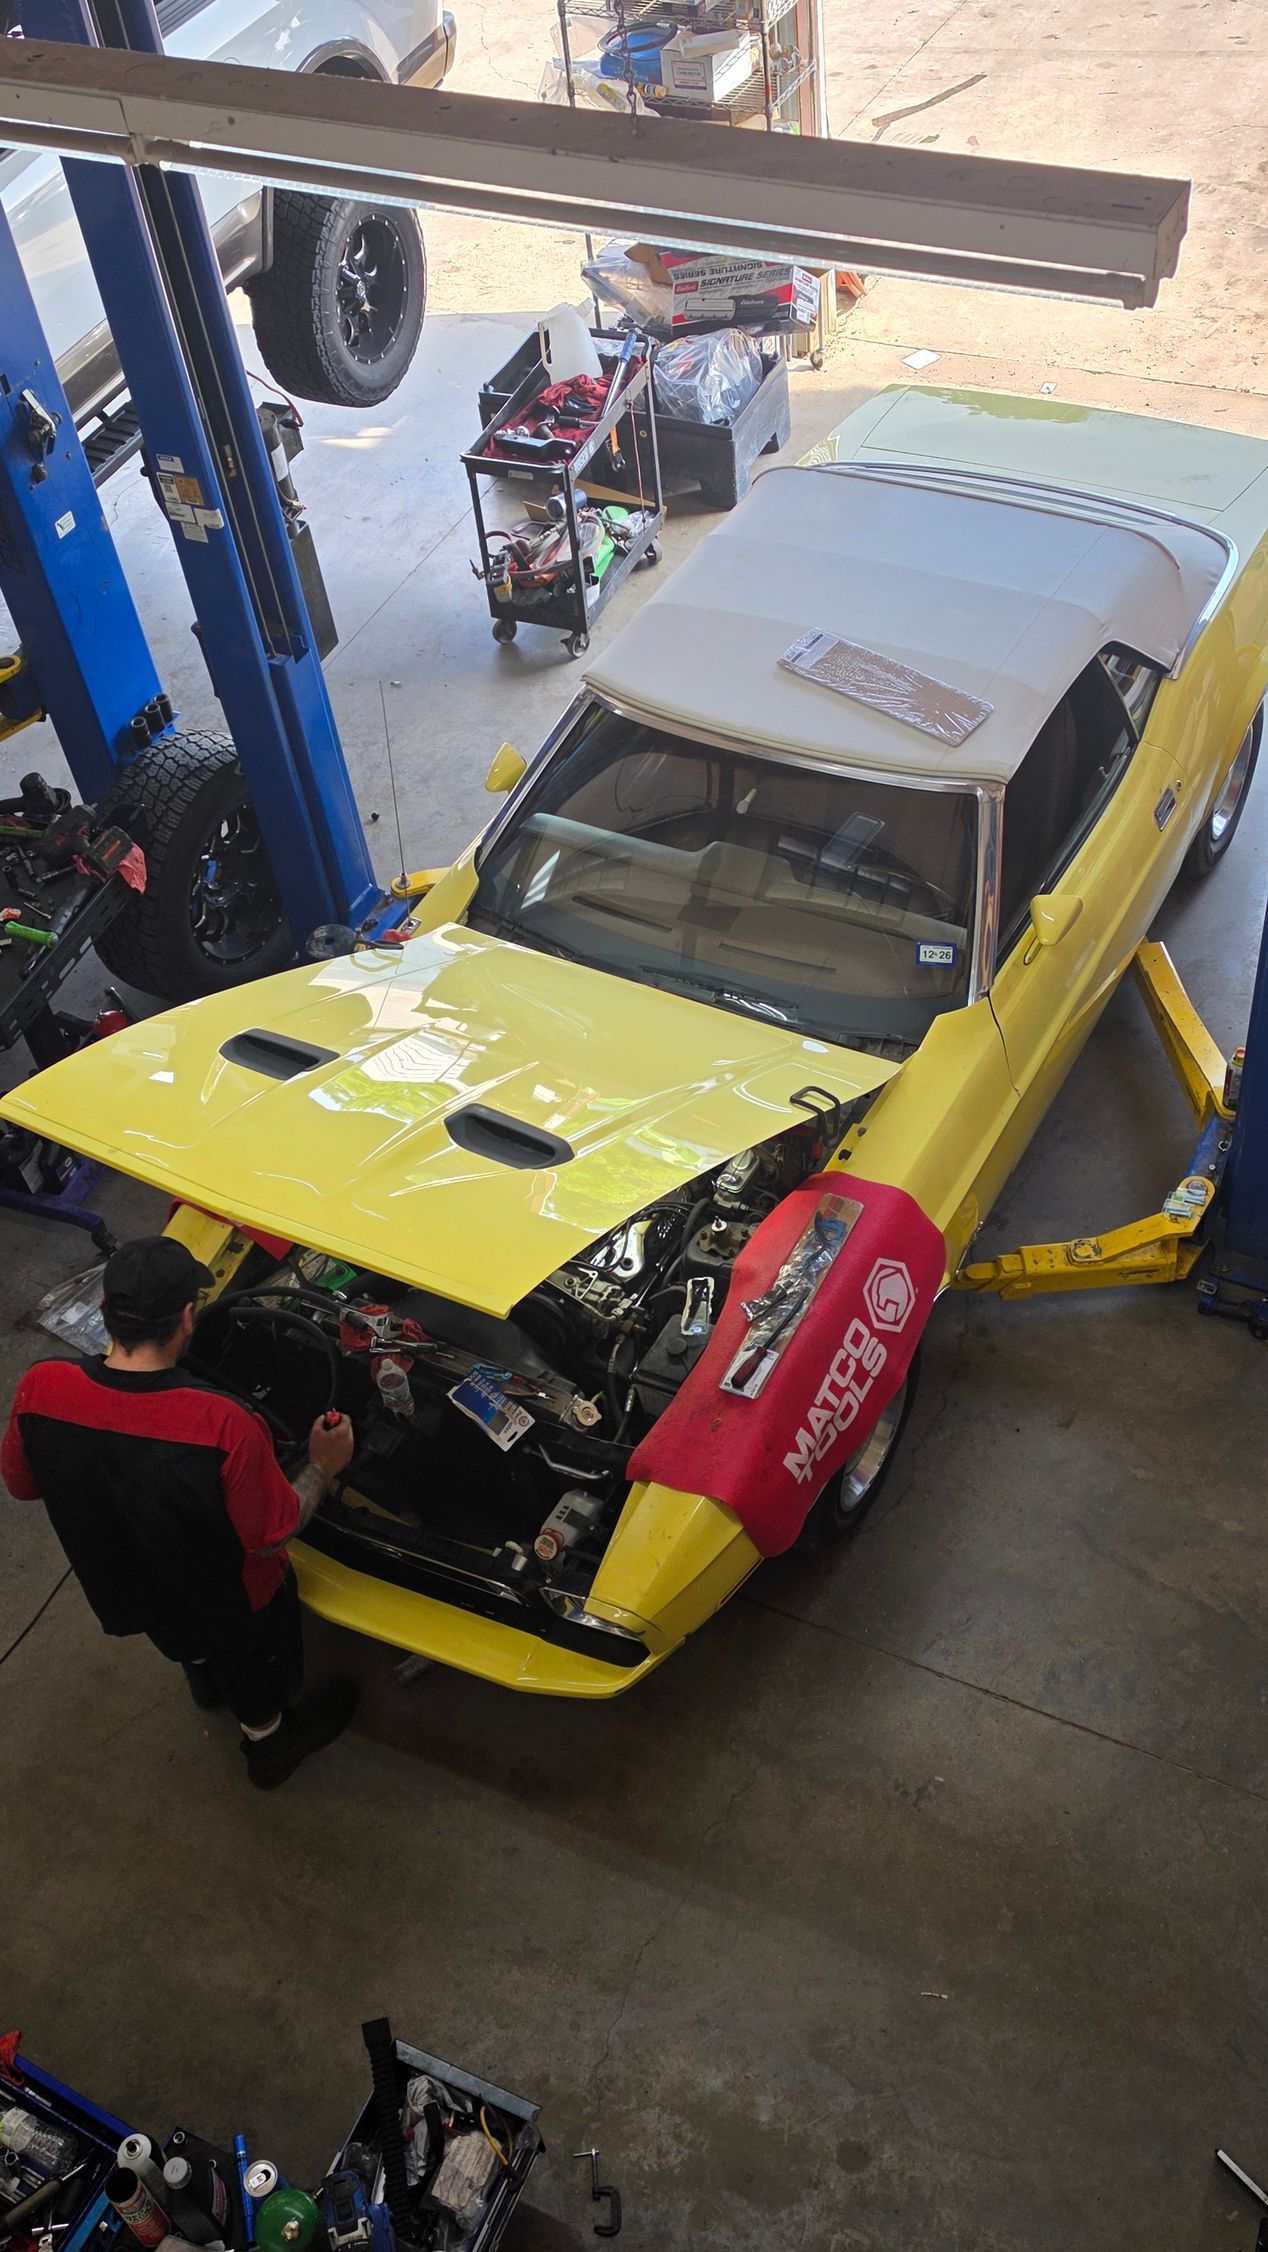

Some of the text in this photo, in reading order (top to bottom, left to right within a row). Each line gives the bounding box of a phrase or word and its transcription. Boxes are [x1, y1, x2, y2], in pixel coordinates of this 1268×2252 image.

[673, 261, 763, 280] SIGNATURE SERIES
[700, 271, 754, 287] SIGNATURE
[756, 265, 791, 280] SERIES
[922, 950, 951, 960] 12 26
[783, 1318, 888, 1485] MATCO TOOLS
